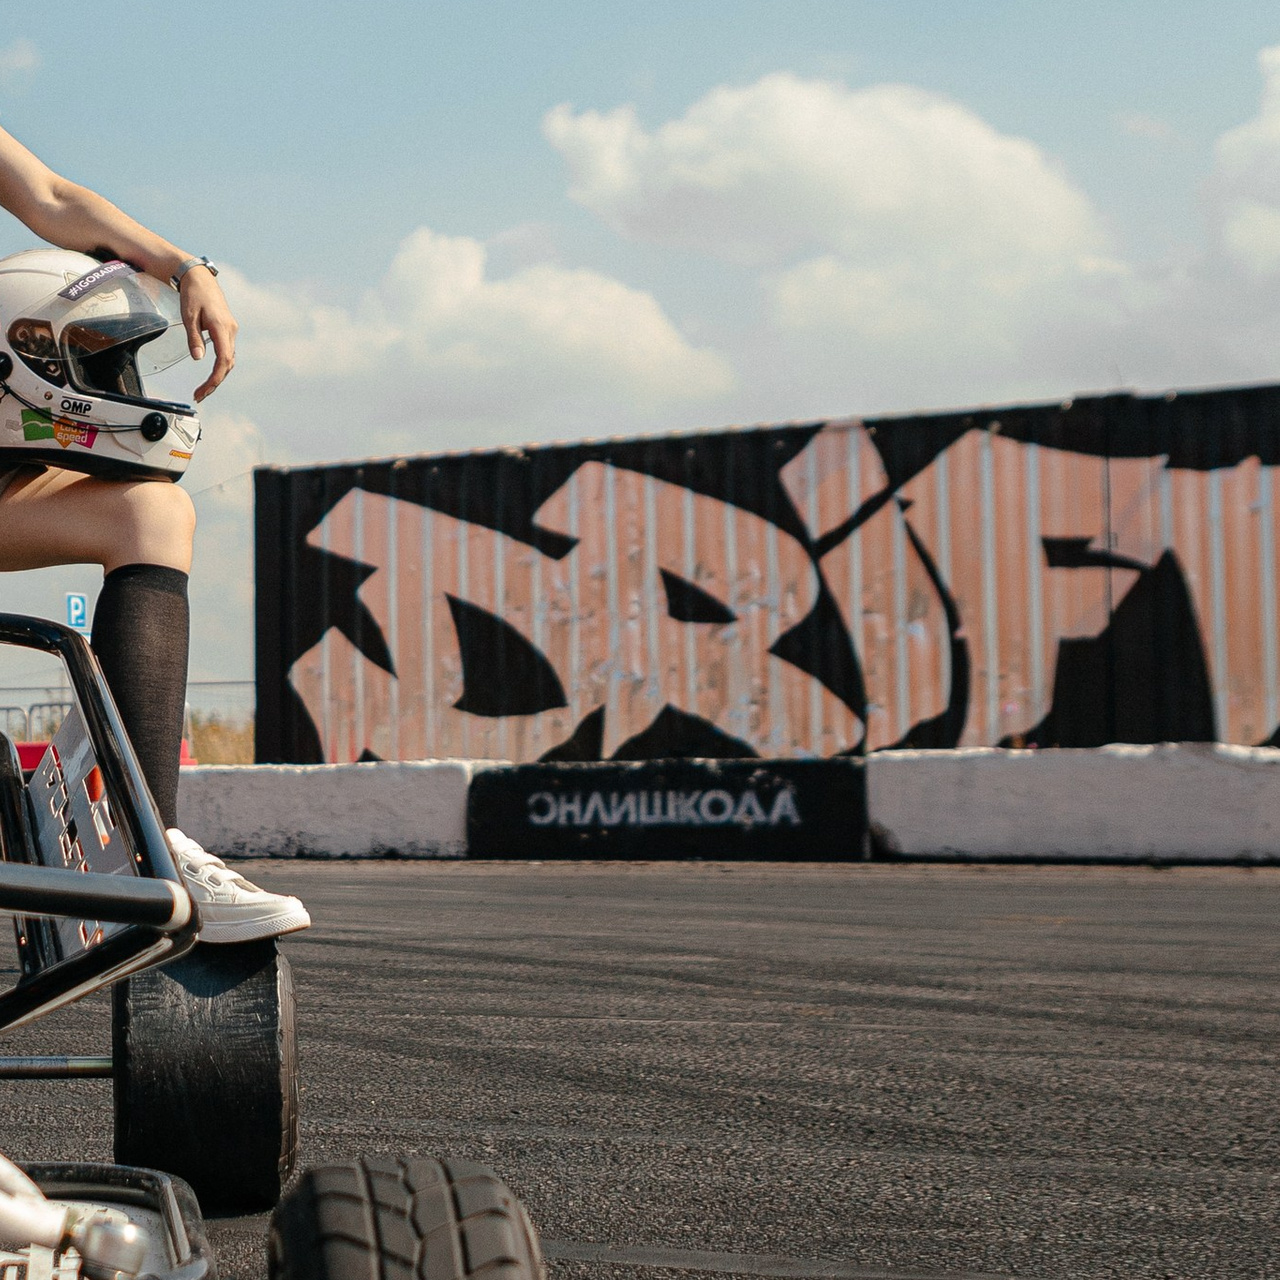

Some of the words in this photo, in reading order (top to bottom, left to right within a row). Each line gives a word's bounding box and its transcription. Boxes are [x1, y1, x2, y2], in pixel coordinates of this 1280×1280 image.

[60, 399, 92, 414] OMP
[56, 431, 88, 443] speed
[71, 597, 83, 625] P
